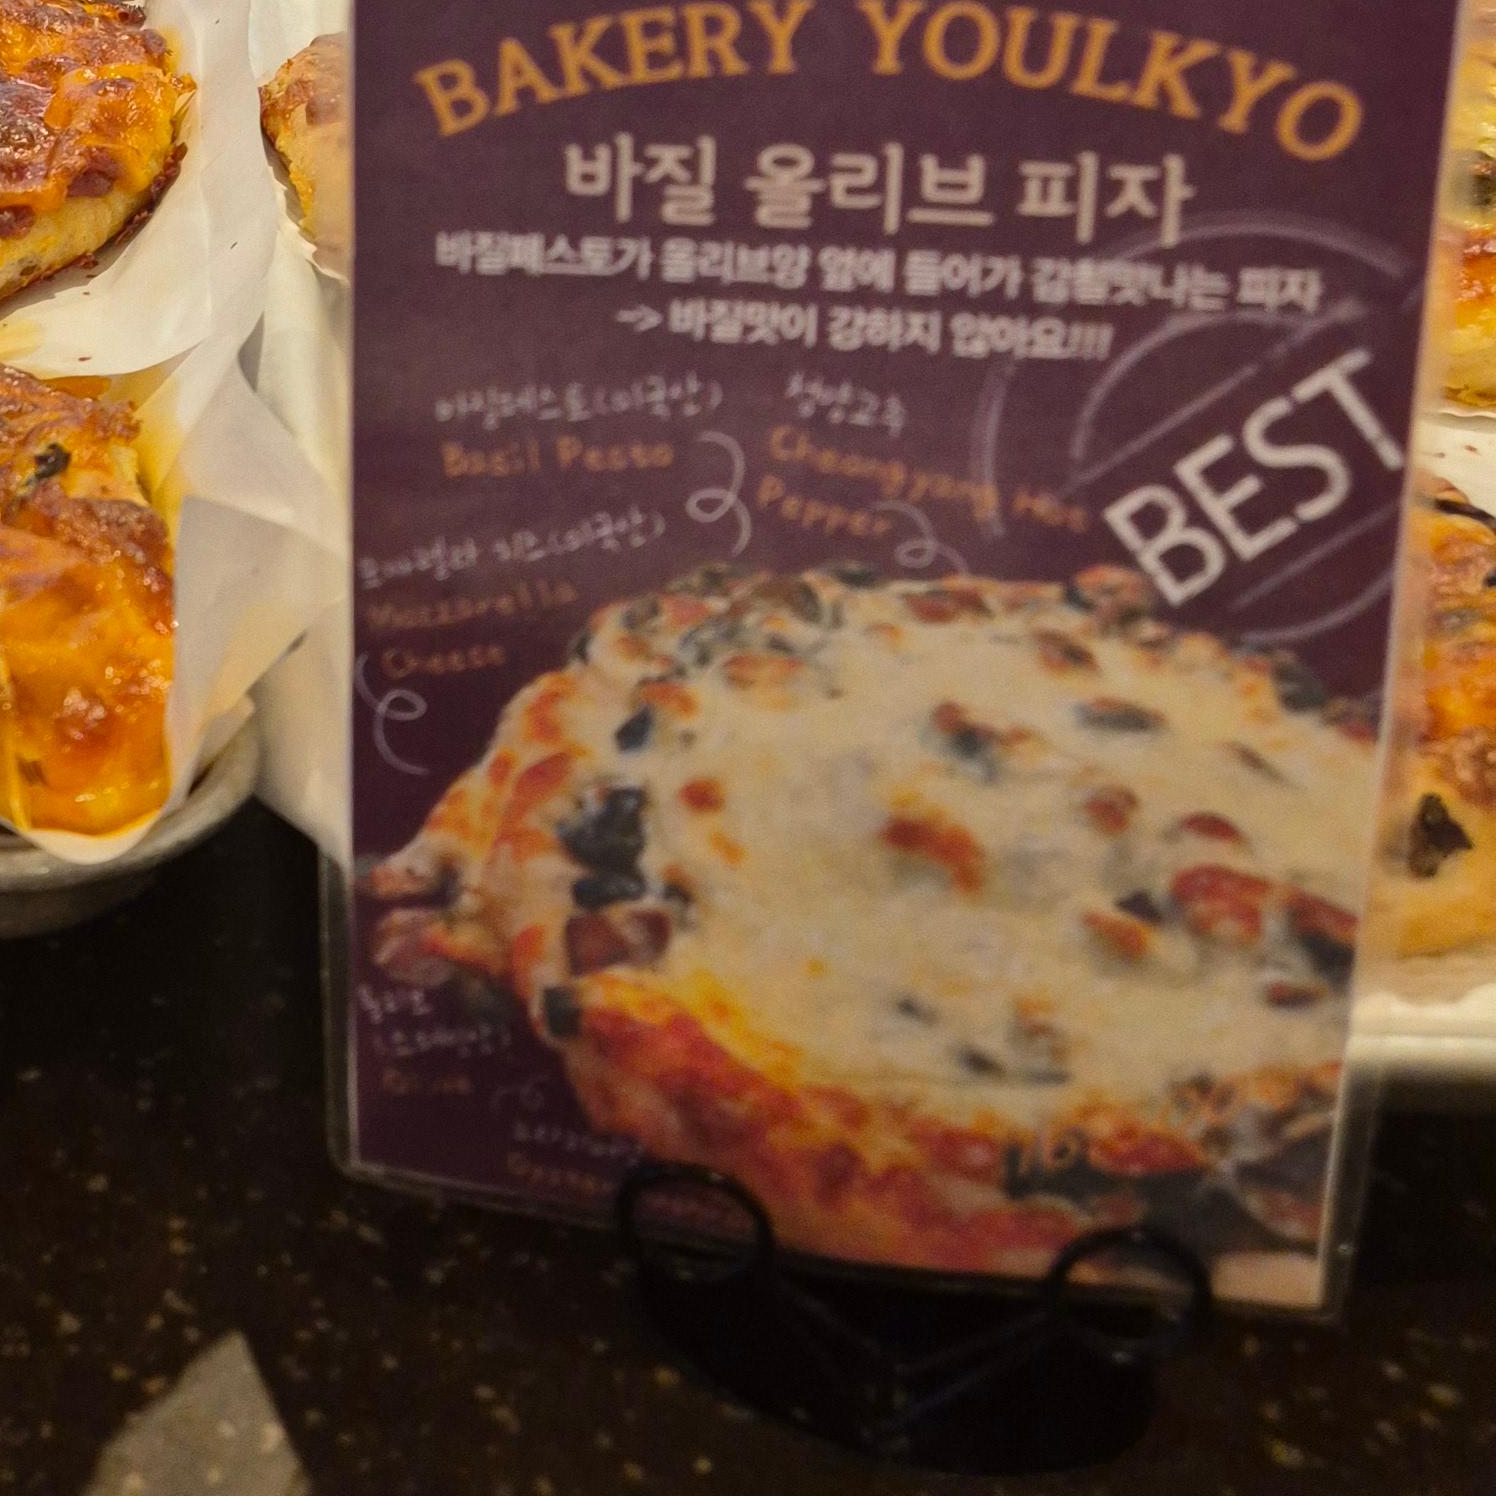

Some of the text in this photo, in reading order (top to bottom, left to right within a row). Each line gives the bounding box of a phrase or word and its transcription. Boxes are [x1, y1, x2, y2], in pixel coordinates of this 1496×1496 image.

[565, 131, 1196, 249] 바질 올리브 피자
[435, 230, 653, 280] 바질페스토가
[905, 249, 1024, 300] 들어가
[1237, 264, 1324, 314] 피자
[668, 298, 819, 349] 바질맛이
[827, 304, 943, 354] 강하지
[441, 434, 675, 479] Basil Pesto
[1102, 348, 1406, 608] BEST
